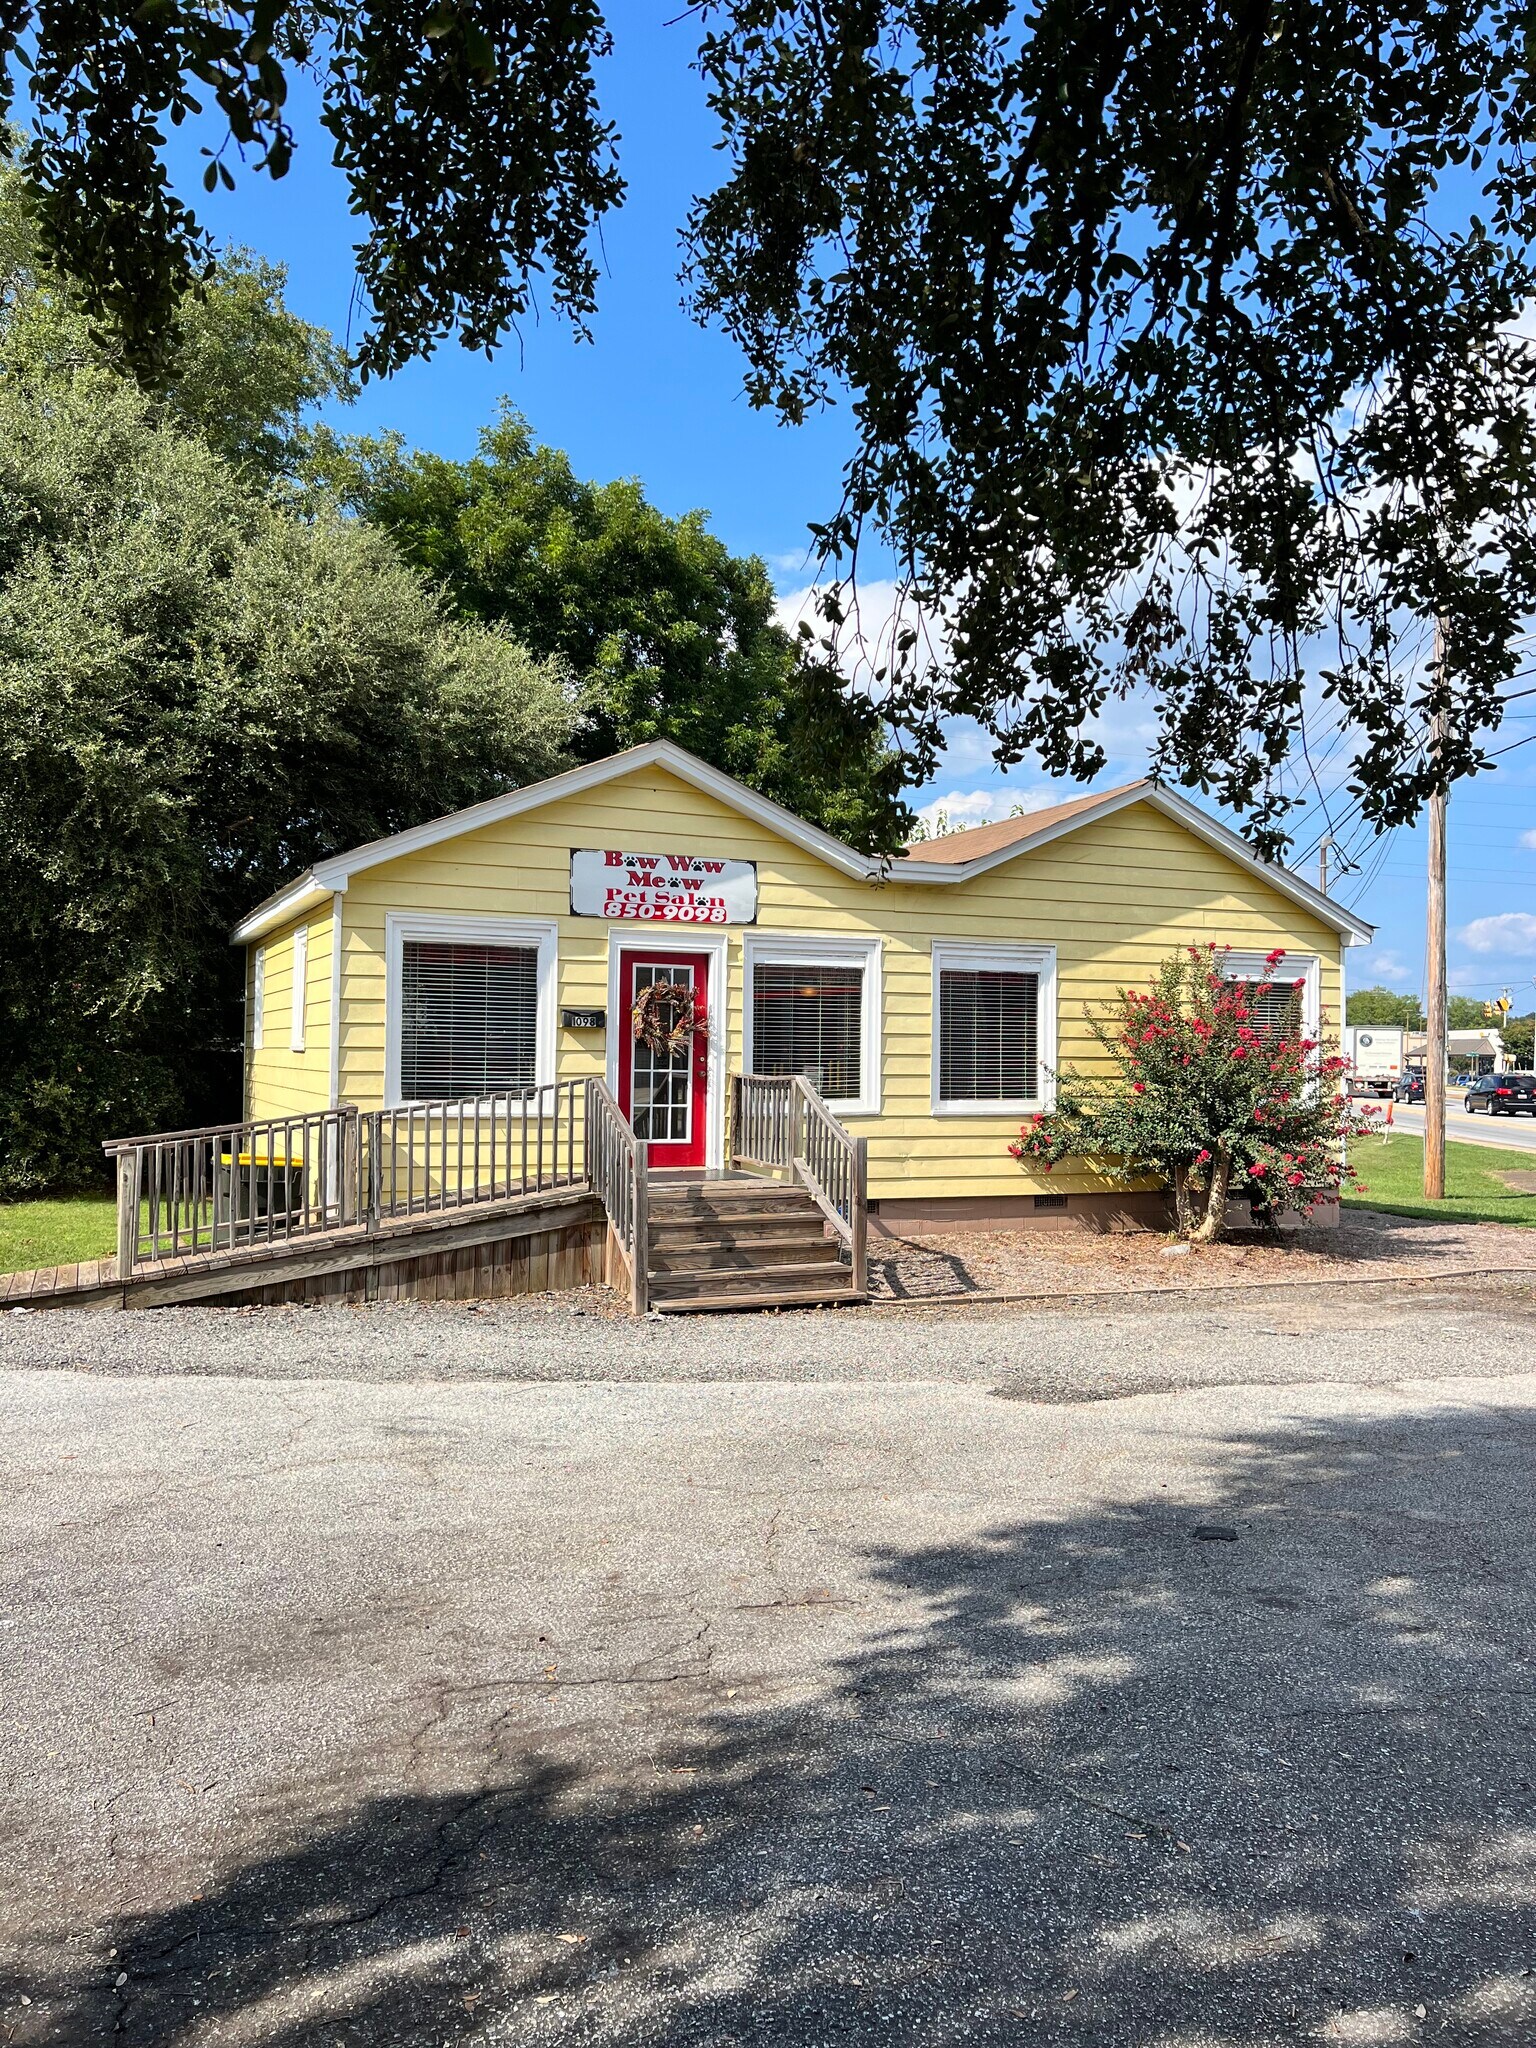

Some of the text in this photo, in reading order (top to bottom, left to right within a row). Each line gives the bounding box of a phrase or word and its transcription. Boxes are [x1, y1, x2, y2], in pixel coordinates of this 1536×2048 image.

[606, 888, 647, 902] Pet
[605, 902, 726, 922] 850-9098
[572, 1017, 596, 1027] 1098
